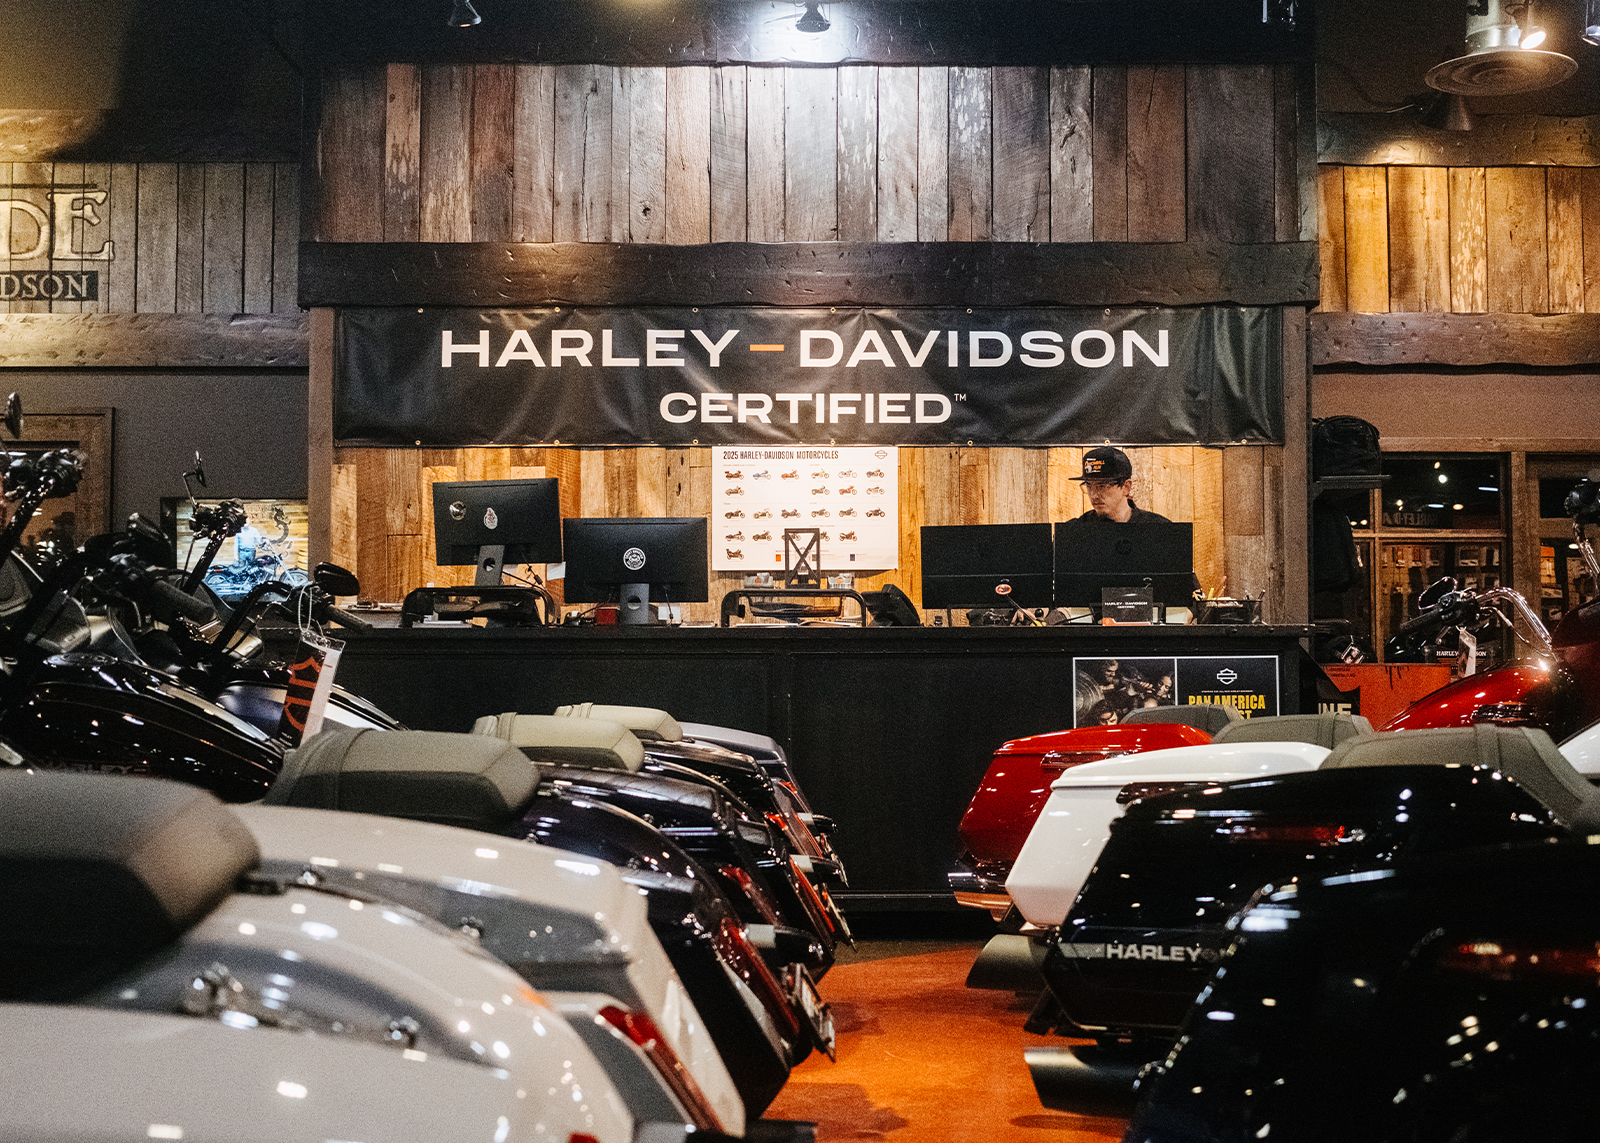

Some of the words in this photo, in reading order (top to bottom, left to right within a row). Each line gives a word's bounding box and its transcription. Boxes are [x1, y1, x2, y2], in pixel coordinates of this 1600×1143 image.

[441, 329, 740, 368] HARLEY
[799, 329, 1169, 368] DAVIDSON
[723, 450, 739, 460] 2025
[740, 450, 794, 460] HARLEY-DAVIDSON
[796, 450, 839, 460] MOTORCYCLES
[1188, 695, 1211, 705] PAN
[1213, 694, 1266, 710] AMERICA
[1106, 943, 1201, 962] HARLEY
